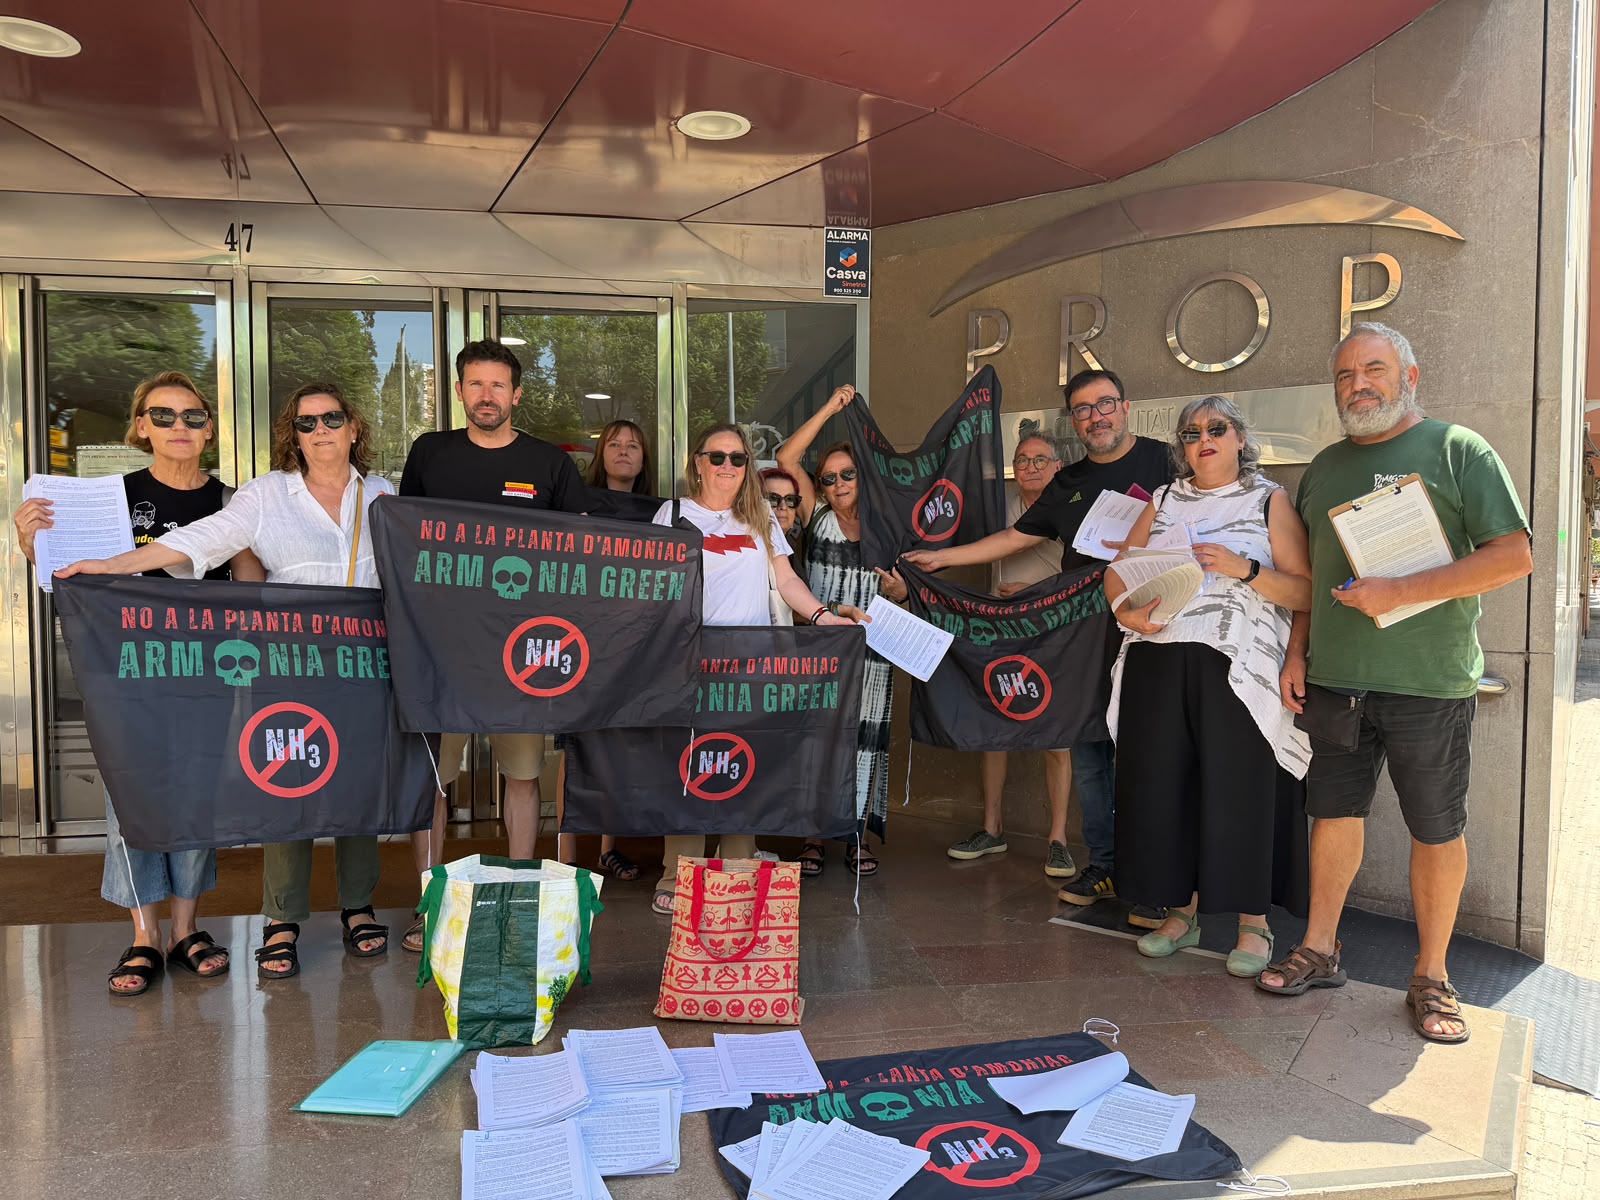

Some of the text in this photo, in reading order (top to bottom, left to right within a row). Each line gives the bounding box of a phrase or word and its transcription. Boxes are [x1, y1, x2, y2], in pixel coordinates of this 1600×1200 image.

[224, 222, 254, 253] 47
[826, 230, 869, 241] ALARMA
[826, 266, 867, 280] Casva
[965, 252, 1402, 387] PROP
[420, 519, 688, 563] NO A LA PLANTA D'AMONIAC
[600, 565, 687, 600] GREEN
[121, 606, 387, 638] NO A LA PLANTA D'AMON
[336, 645, 390, 679] GRE
[525, 638, 572, 675] NH3
[700, 656, 839, 675] ANTA D'AMONIAC
[763, 681, 839, 713] GREEN
[996, 671, 1039, 699] NH3
[265, 728, 321, 768] NH3
[698, 750, 740, 780] NH3
[948, 1054, 1074, 1079] D'AMONIAC
